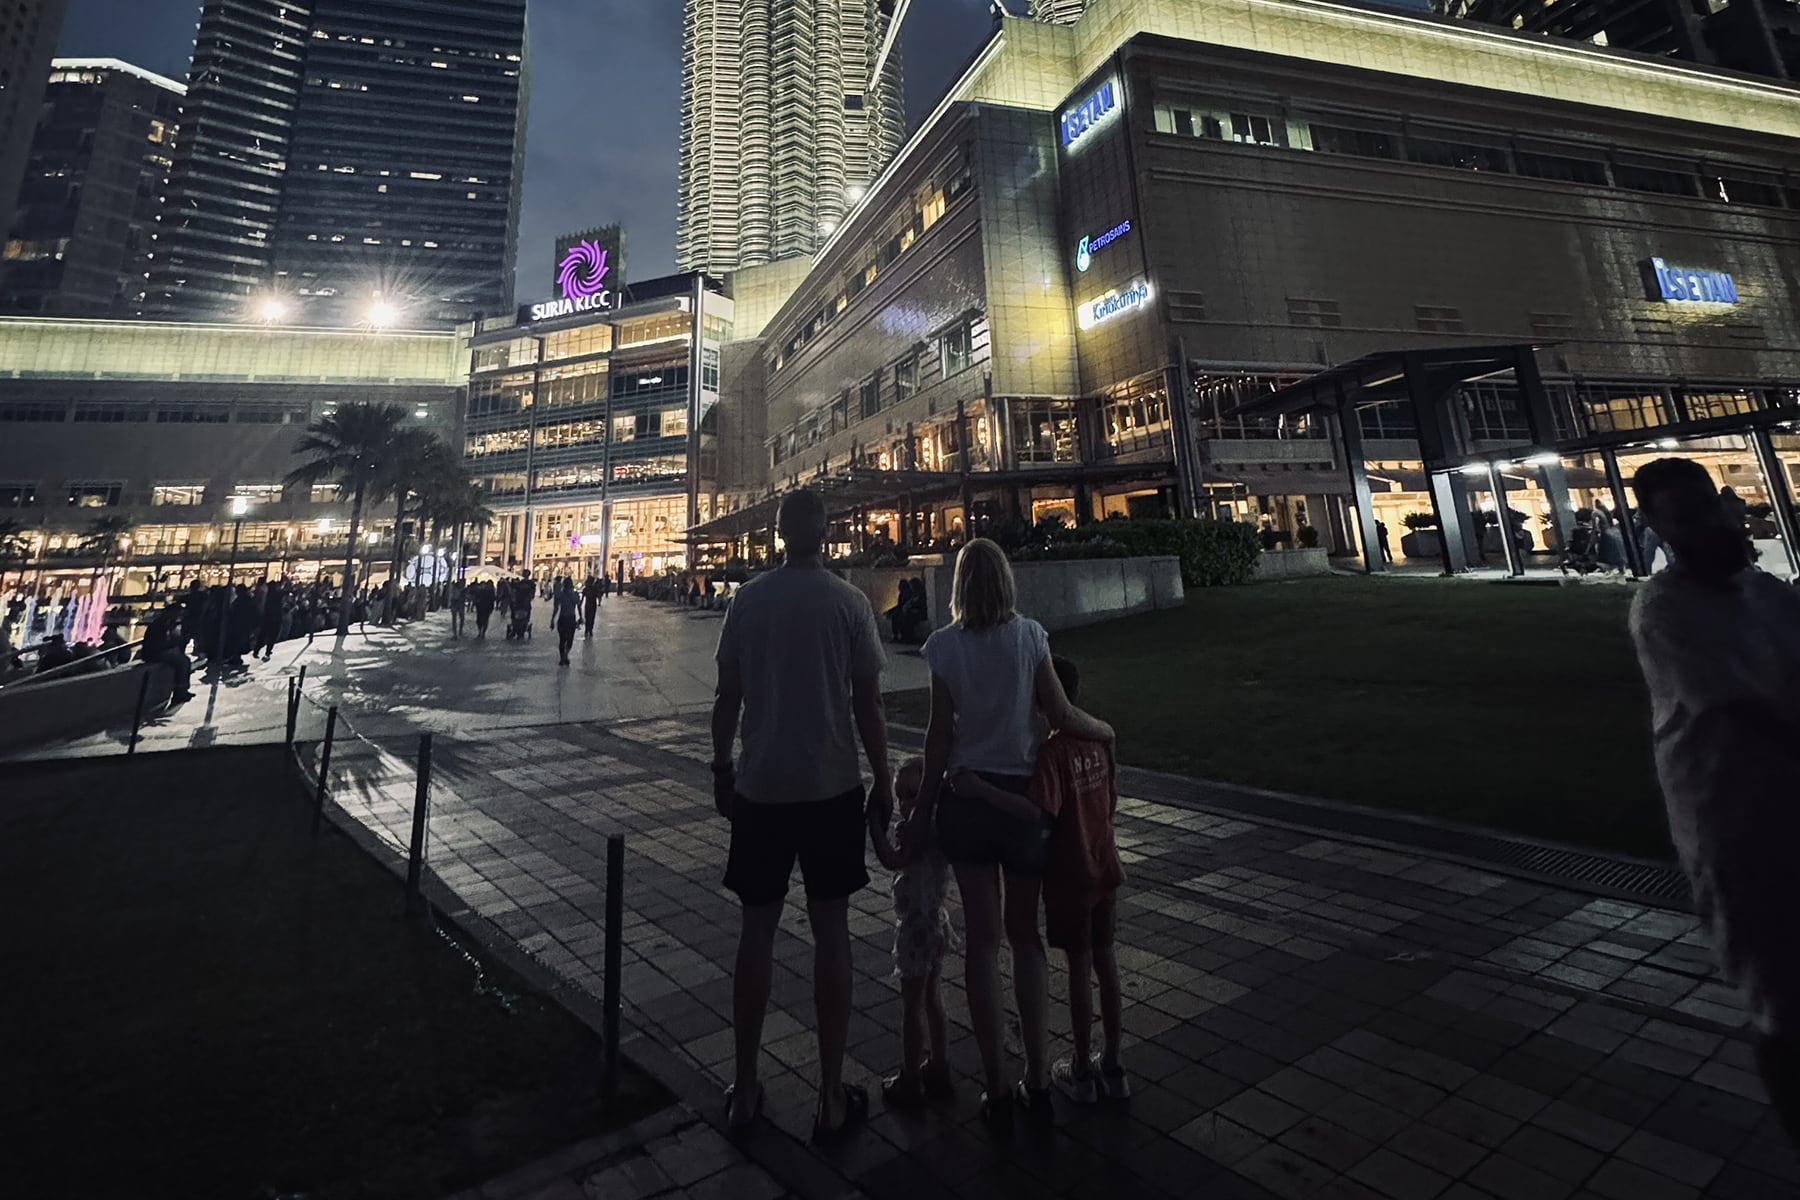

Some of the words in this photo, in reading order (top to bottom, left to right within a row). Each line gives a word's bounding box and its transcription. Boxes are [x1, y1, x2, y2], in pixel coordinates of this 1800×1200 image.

[1088, 220, 1131, 253] PETROSAINS
[532, 298, 573, 320] SURIA
[575, 290, 610, 311] KLCC
